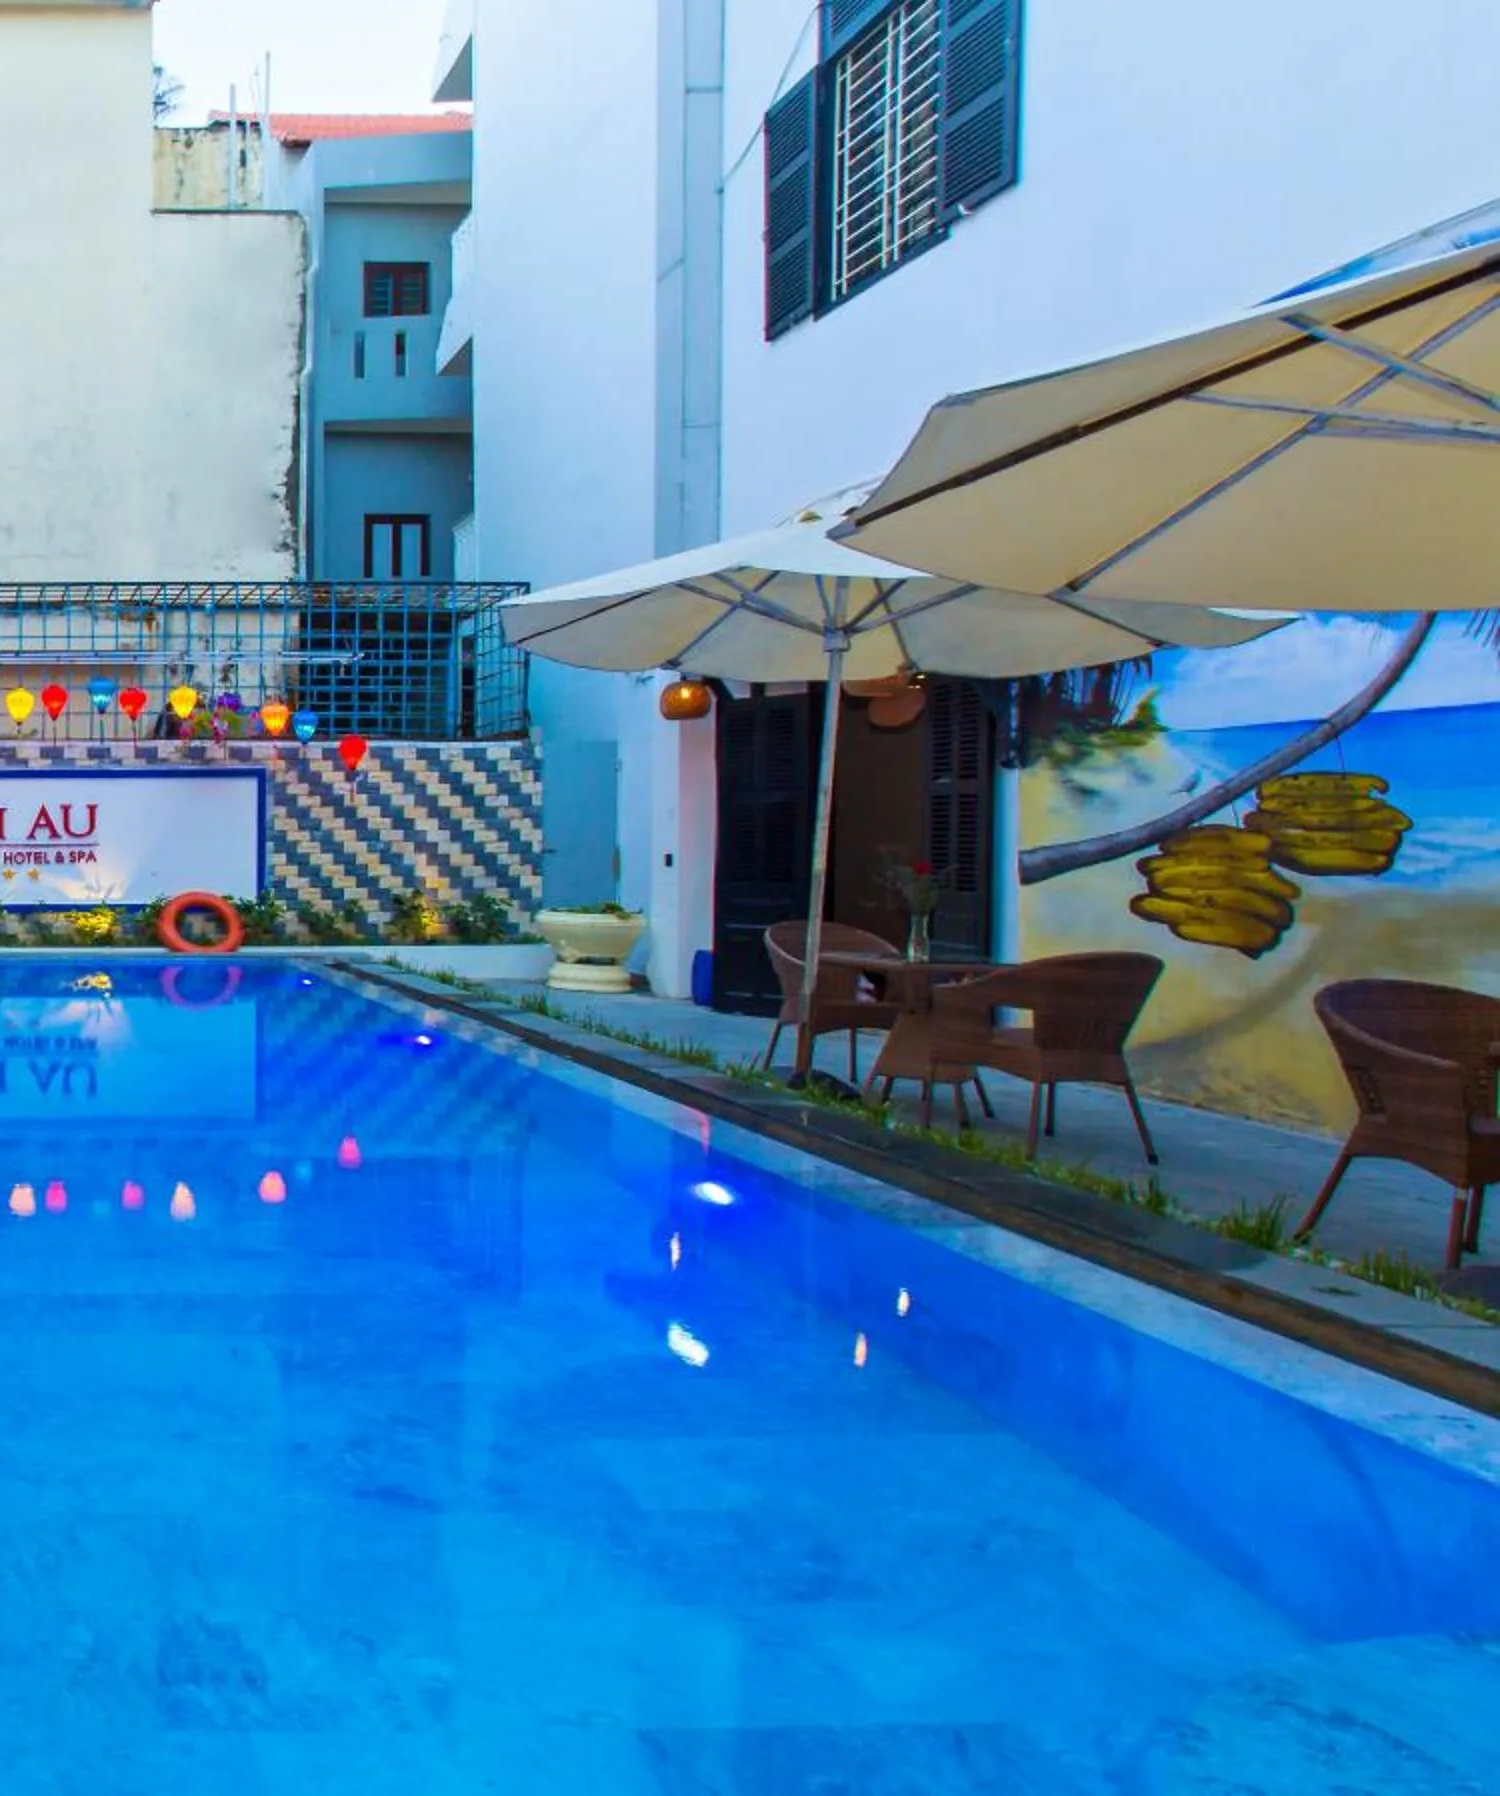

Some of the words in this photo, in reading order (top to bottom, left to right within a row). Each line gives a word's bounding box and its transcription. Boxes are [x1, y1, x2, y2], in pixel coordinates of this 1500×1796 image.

[26, 803, 98, 840] AU
[3, 851, 51, 865] HOTEL
[54, 850, 65, 864] &
[68, 850, 97, 864] SPA
